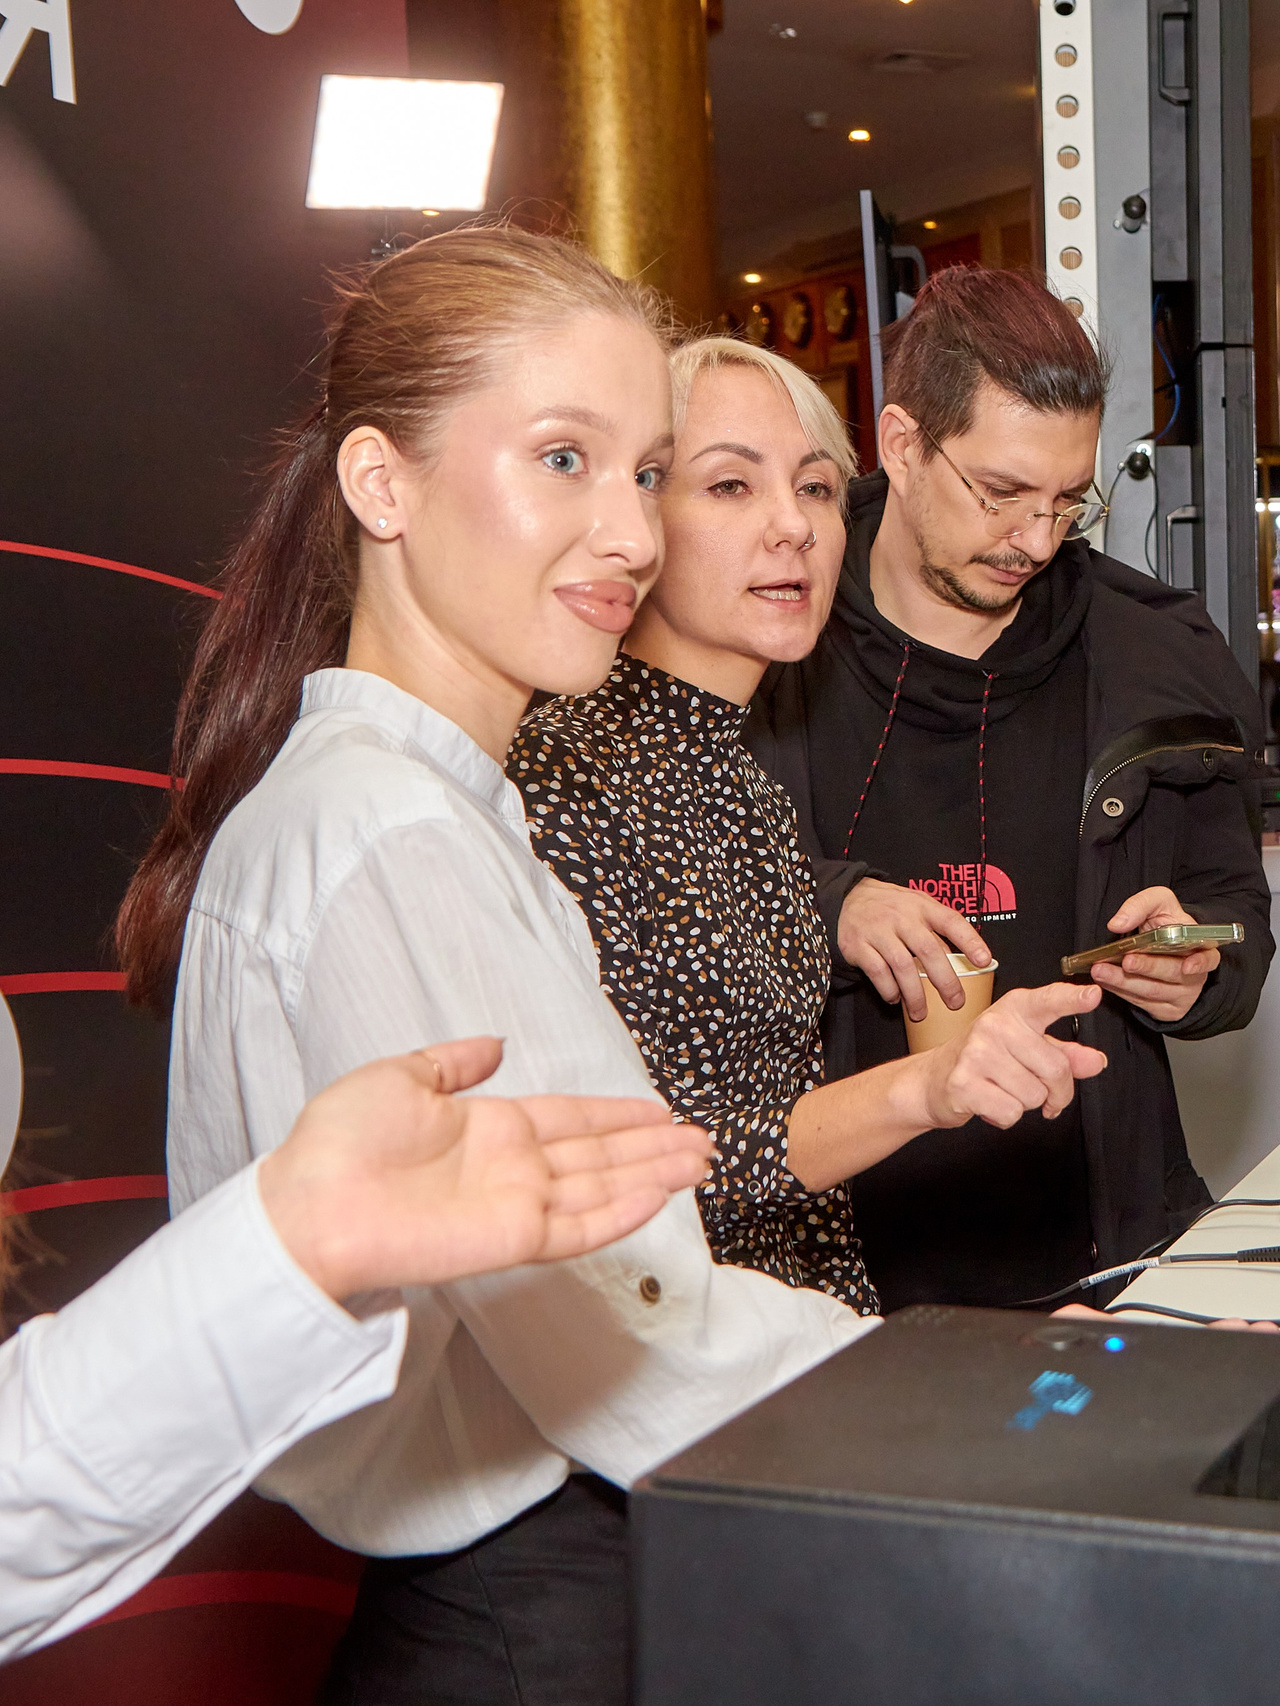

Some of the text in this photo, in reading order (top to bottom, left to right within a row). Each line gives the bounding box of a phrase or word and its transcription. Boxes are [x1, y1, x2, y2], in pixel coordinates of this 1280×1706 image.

[938, 863, 976, 881] THE
[908, 879, 977, 898] NORTH
[936, 896, 978, 914] ACE
